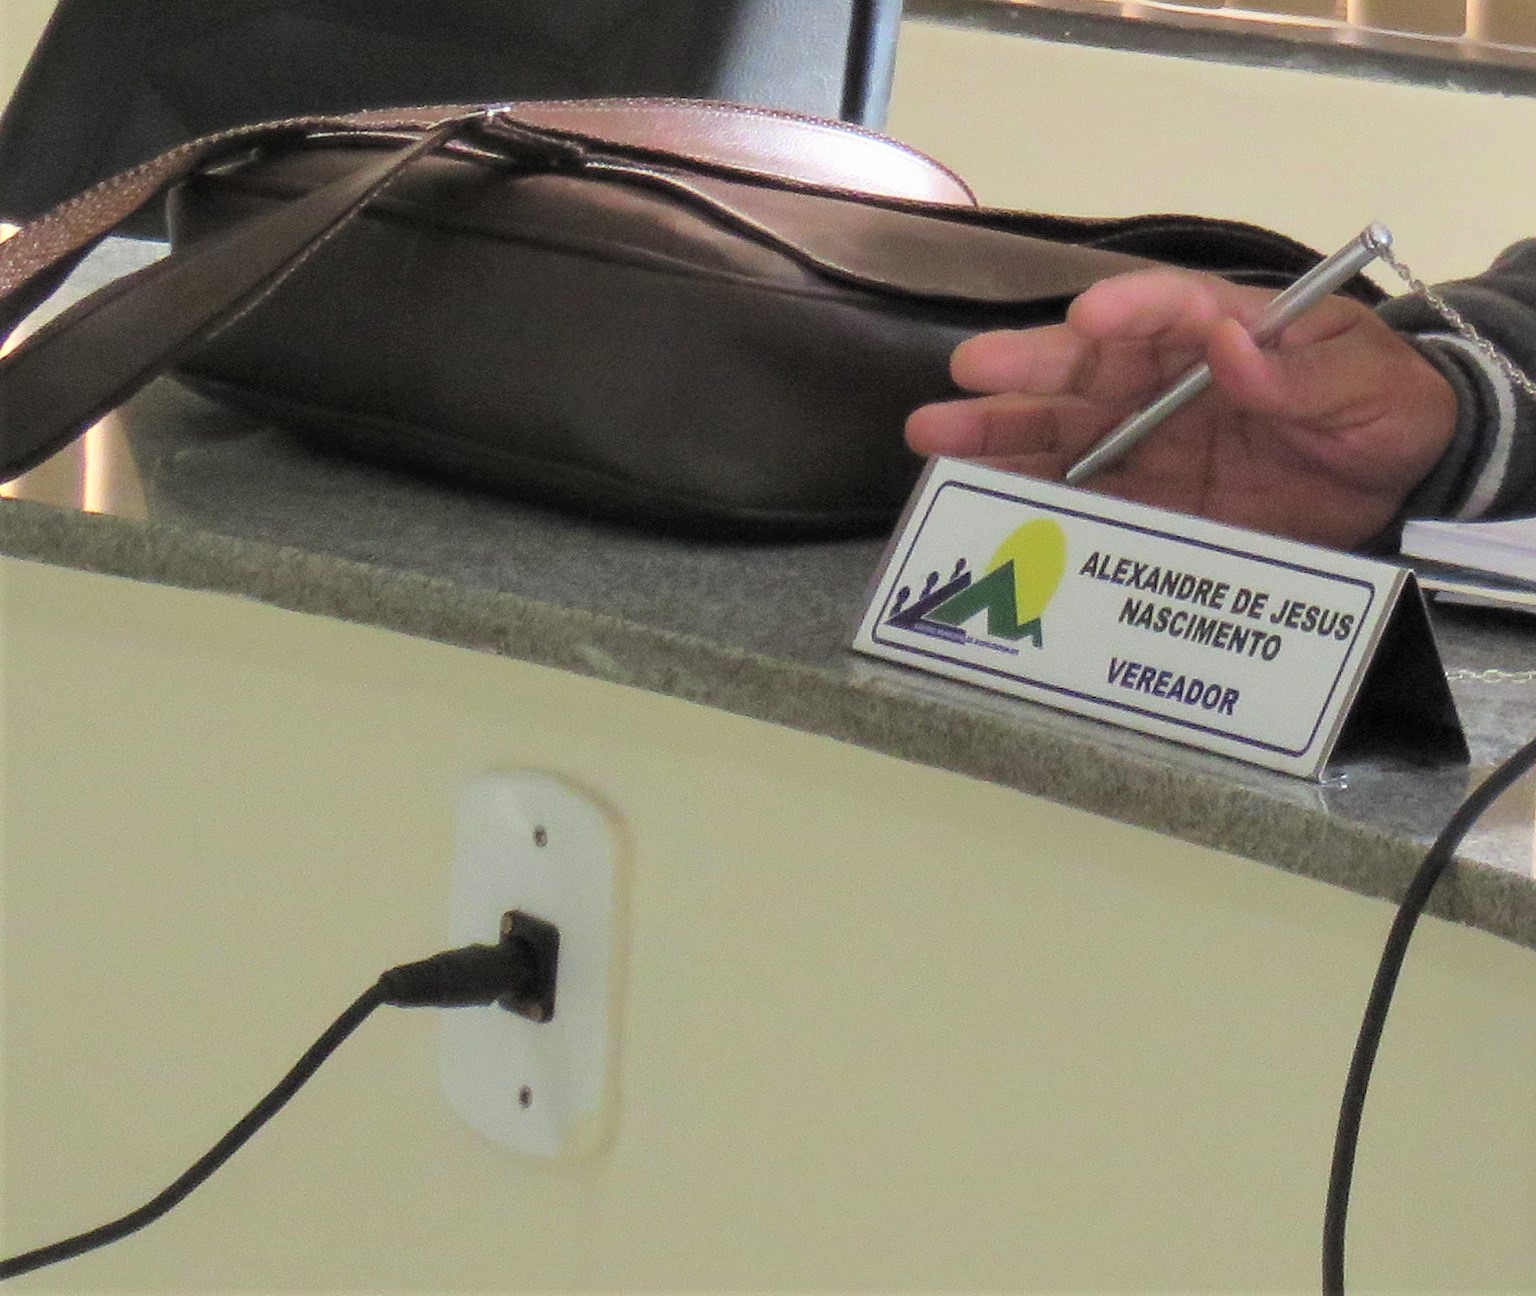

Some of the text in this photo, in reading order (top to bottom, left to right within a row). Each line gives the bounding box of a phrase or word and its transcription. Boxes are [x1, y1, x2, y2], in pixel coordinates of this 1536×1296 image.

[1079, 552, 1354, 641] ALEXANDRE DE JESUS
[1118, 598, 1282, 661] NASCIMENTO
[1107, 657, 1240, 715] VEREADOR
